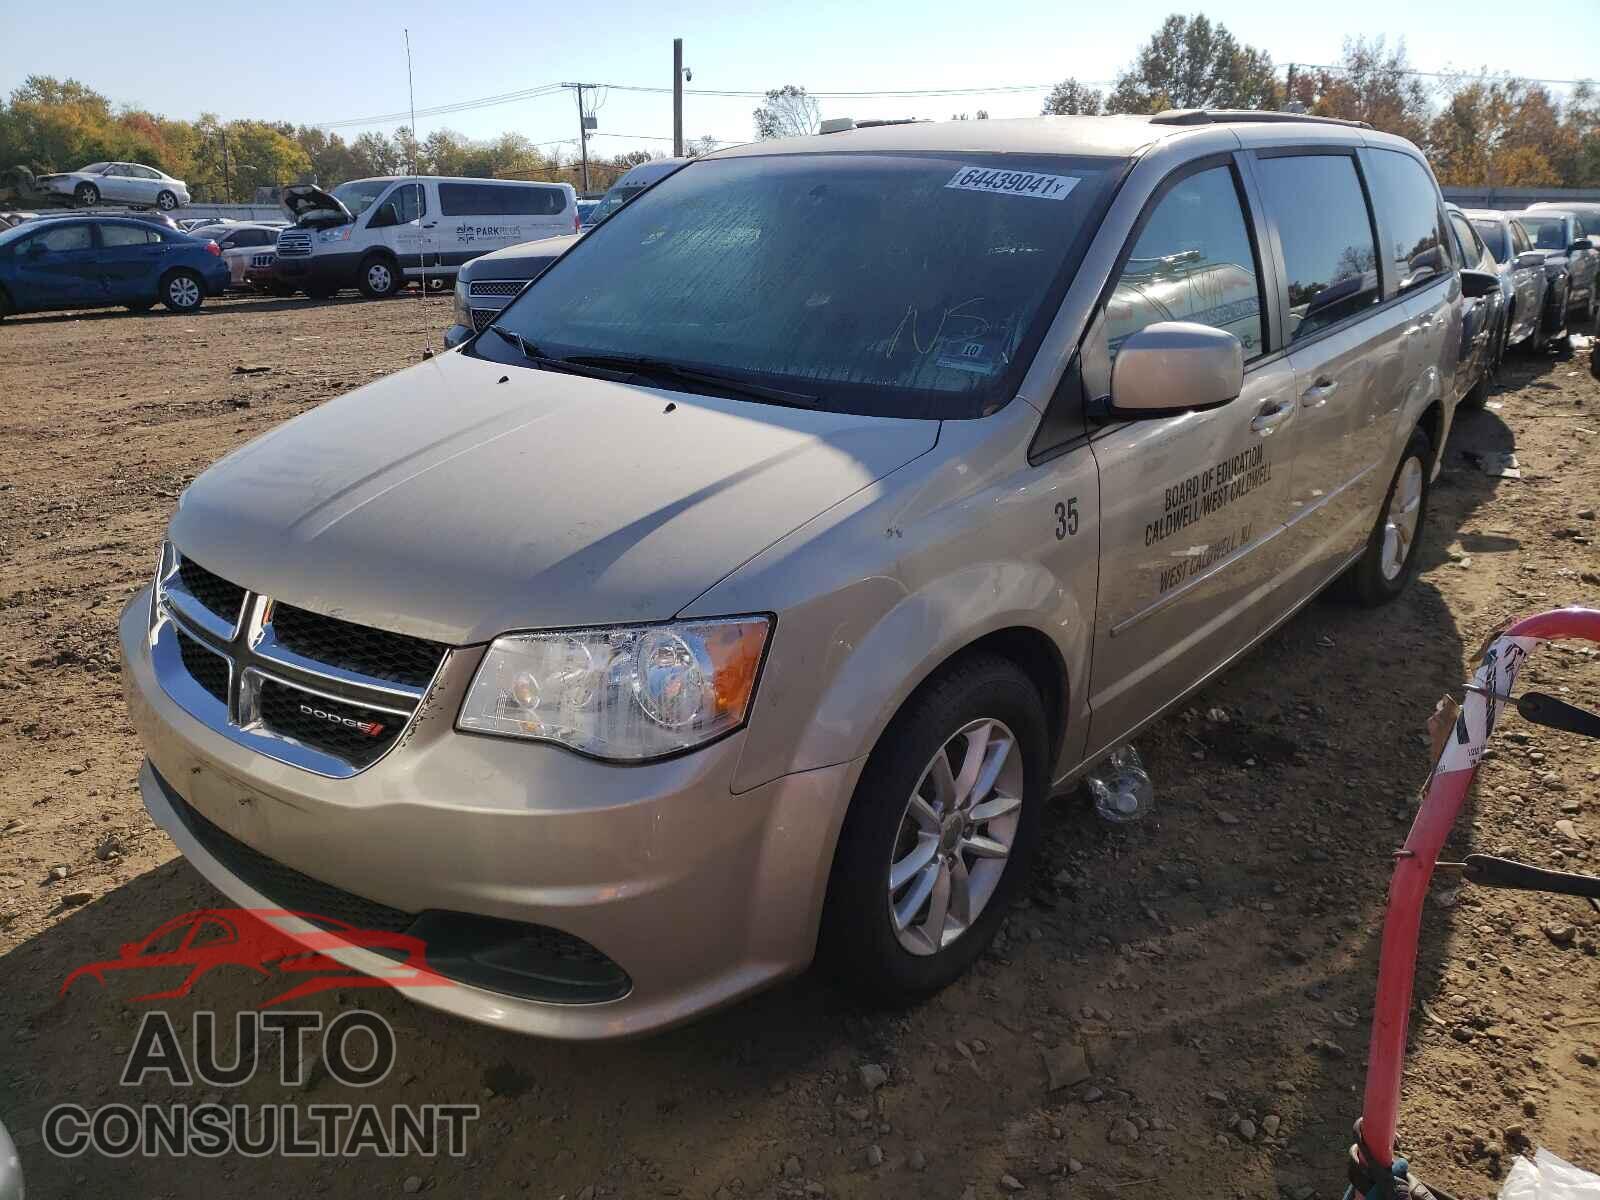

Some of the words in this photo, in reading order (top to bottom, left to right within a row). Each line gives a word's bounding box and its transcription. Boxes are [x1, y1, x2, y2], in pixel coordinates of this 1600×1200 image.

[1165, 476, 1199, 511] BOARD
[1201, 468, 1214, 493] OF
[1216, 442, 1263, 485] EDUCATION
[1054, 496, 1079, 541] 35
[1145, 484, 1229, 547] CALDWELL/WEST
[1230, 459, 1272, 503] CALDWELL
[1160, 562, 1189, 594] WEST
[300, 704, 371, 734] DODGE
